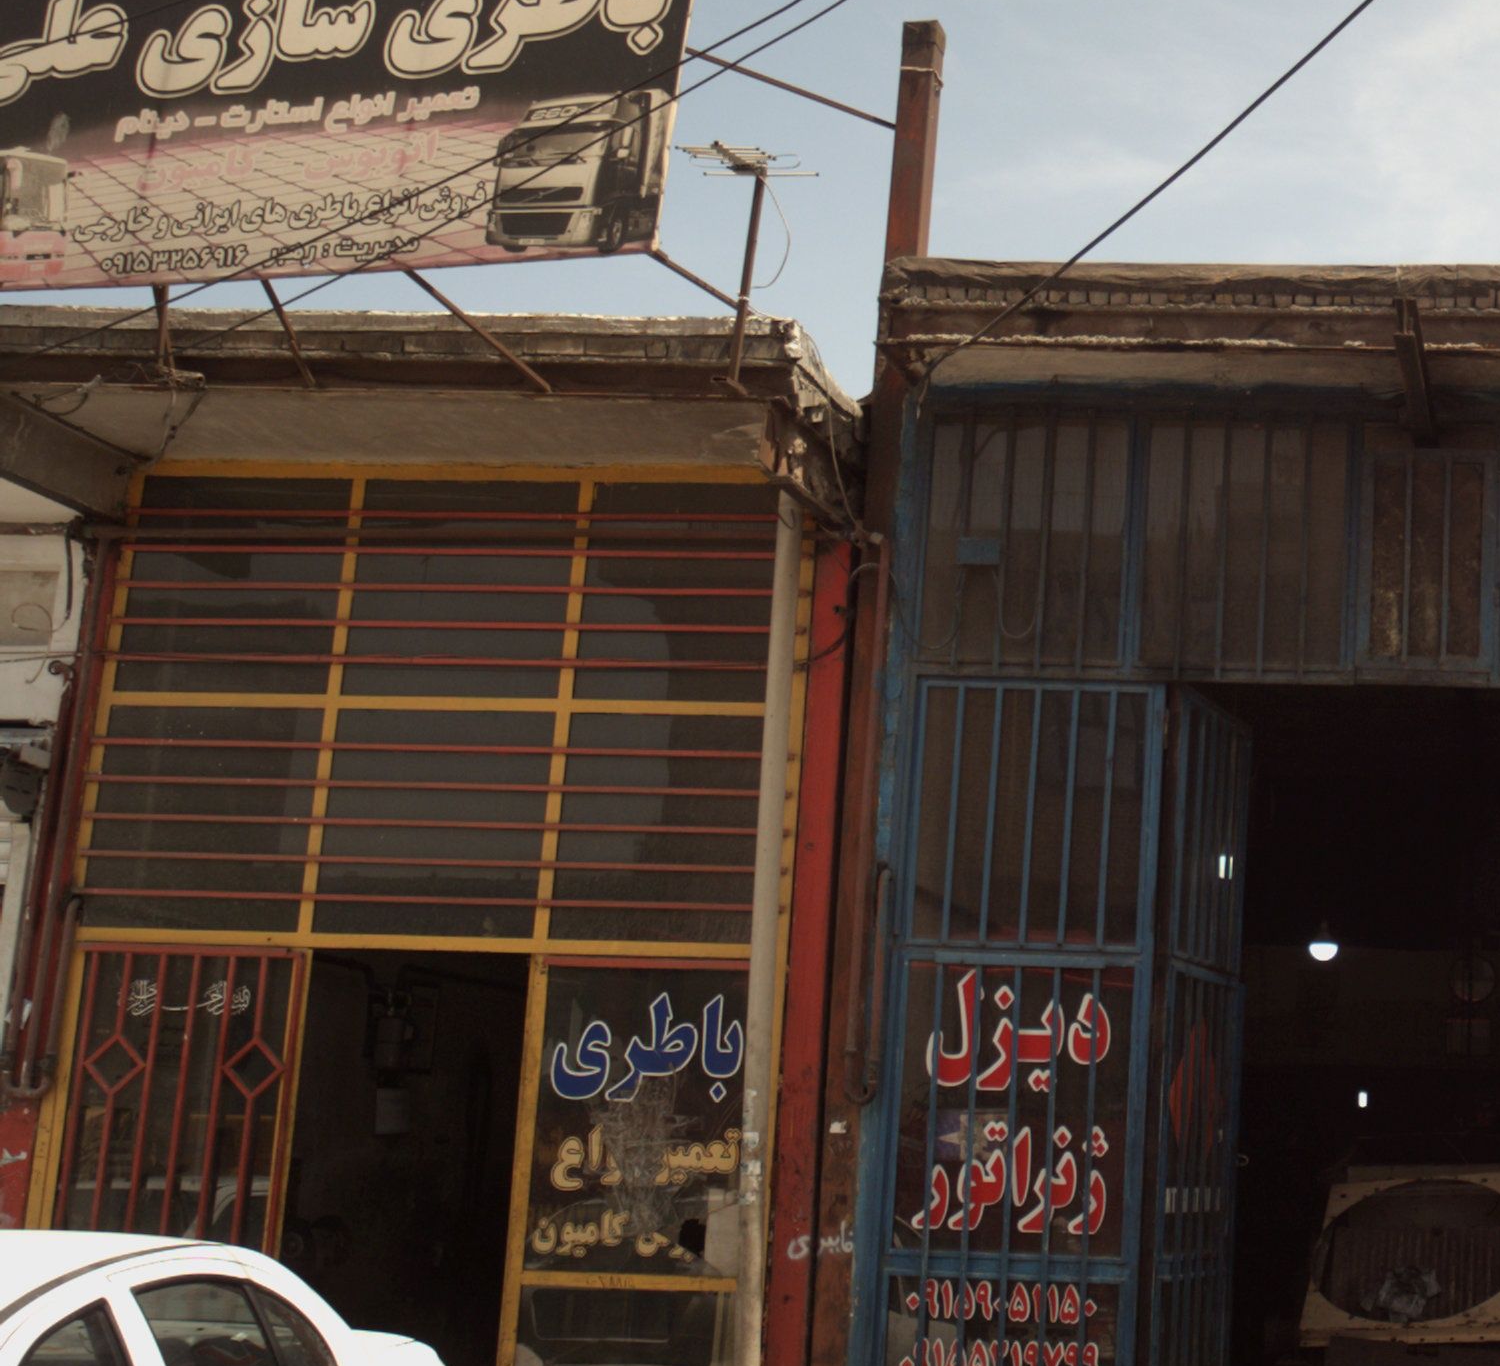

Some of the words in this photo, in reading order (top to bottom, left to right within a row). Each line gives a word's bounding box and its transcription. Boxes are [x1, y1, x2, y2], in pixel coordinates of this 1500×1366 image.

[220, 96, 324, 133] استارت
[324, 91, 396, 133] انواع
[396, 86, 480, 122] تعمیر
[303, 129, 440, 180] اتوبوس
[171, 199, 242, 237] ایرانی
[241, 197, 287, 233] های
[288, 191, 359, 230] باطری
[358, 187, 420, 226] انواع
[418, 181, 487, 221] فروش
[72, 205, 153, 244] خارجی
[152, 215, 169, 240] و
[551, 992, 744, 1103] باطری
[926, 968, 1111, 1092] دیزل
[655, 1128, 743, 1185] تعمیر
[911, 1121, 1110, 1235] ژنراتور
[531, 1210, 629, 1259] کامیون
